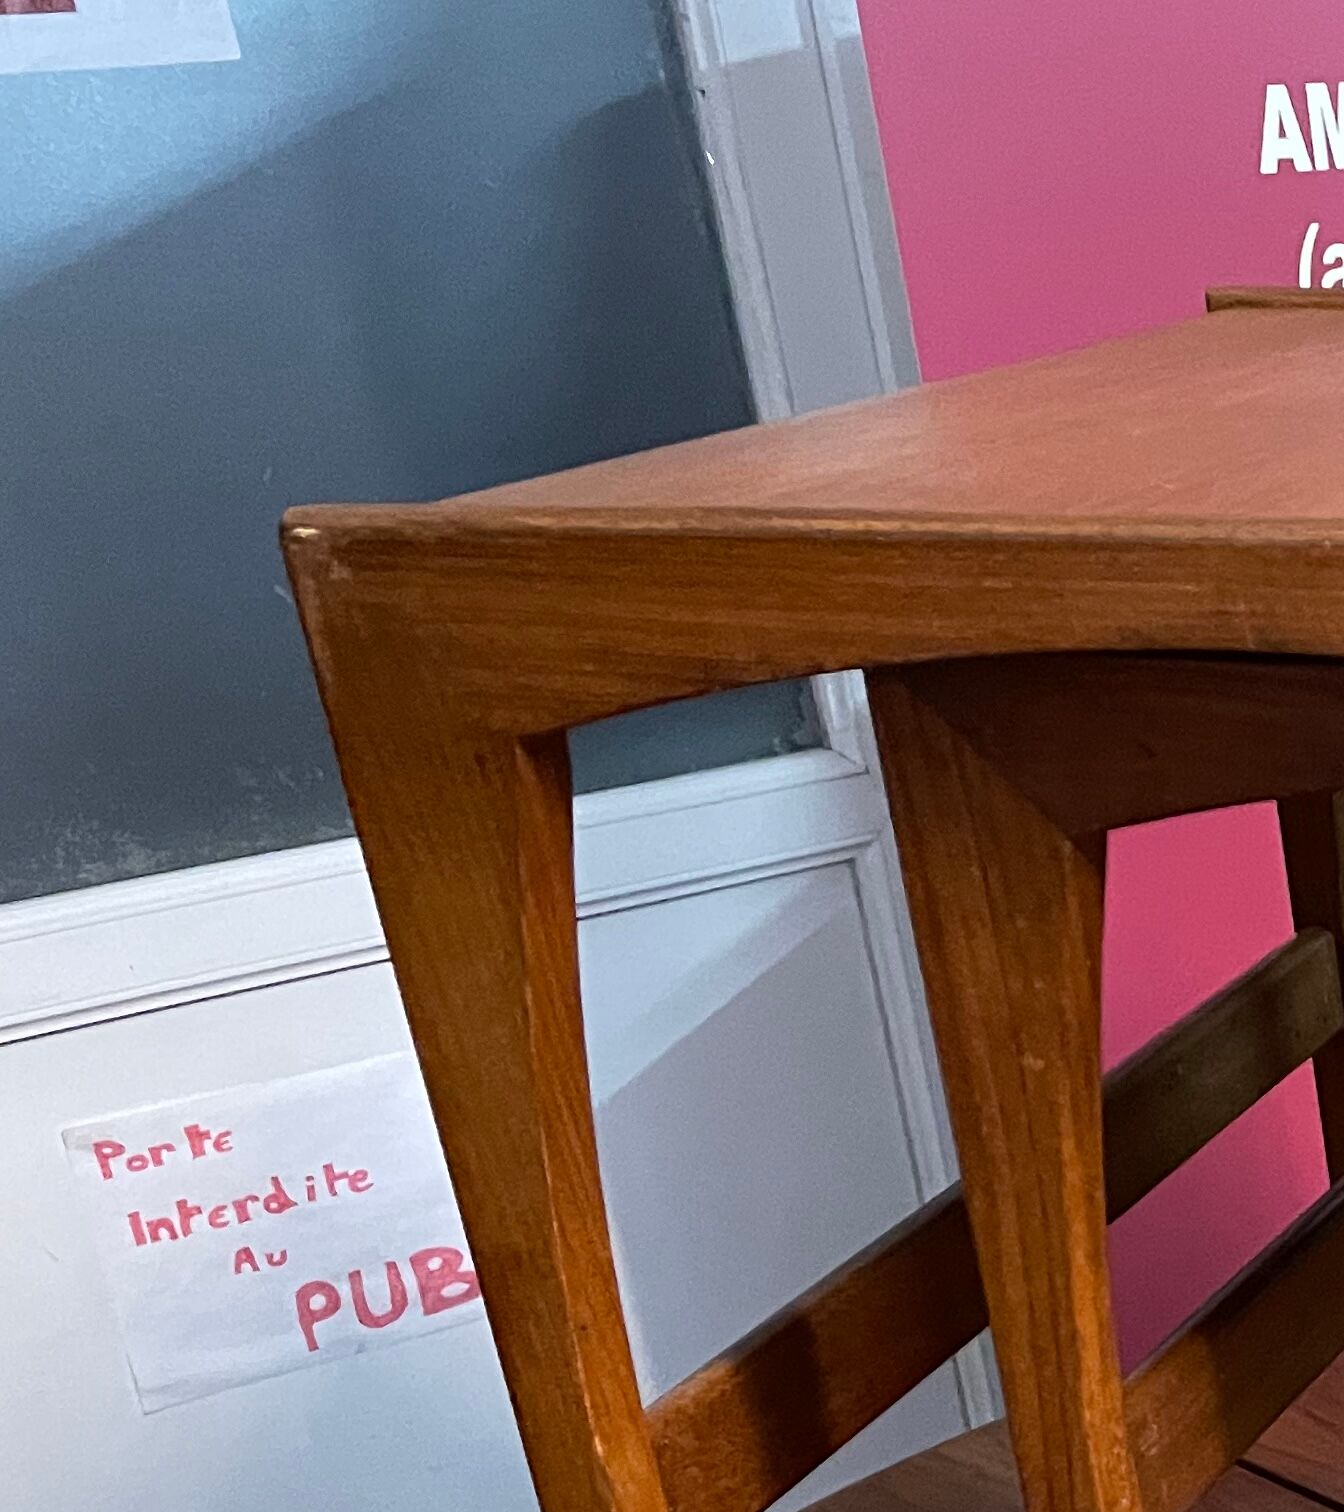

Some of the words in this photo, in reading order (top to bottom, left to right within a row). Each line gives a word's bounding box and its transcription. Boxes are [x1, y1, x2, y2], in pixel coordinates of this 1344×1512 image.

[92, 1124, 233, 1180] Porte
[127, 1163, 375, 1247] Interdite
[295, 1246, 482, 1353] PUB
